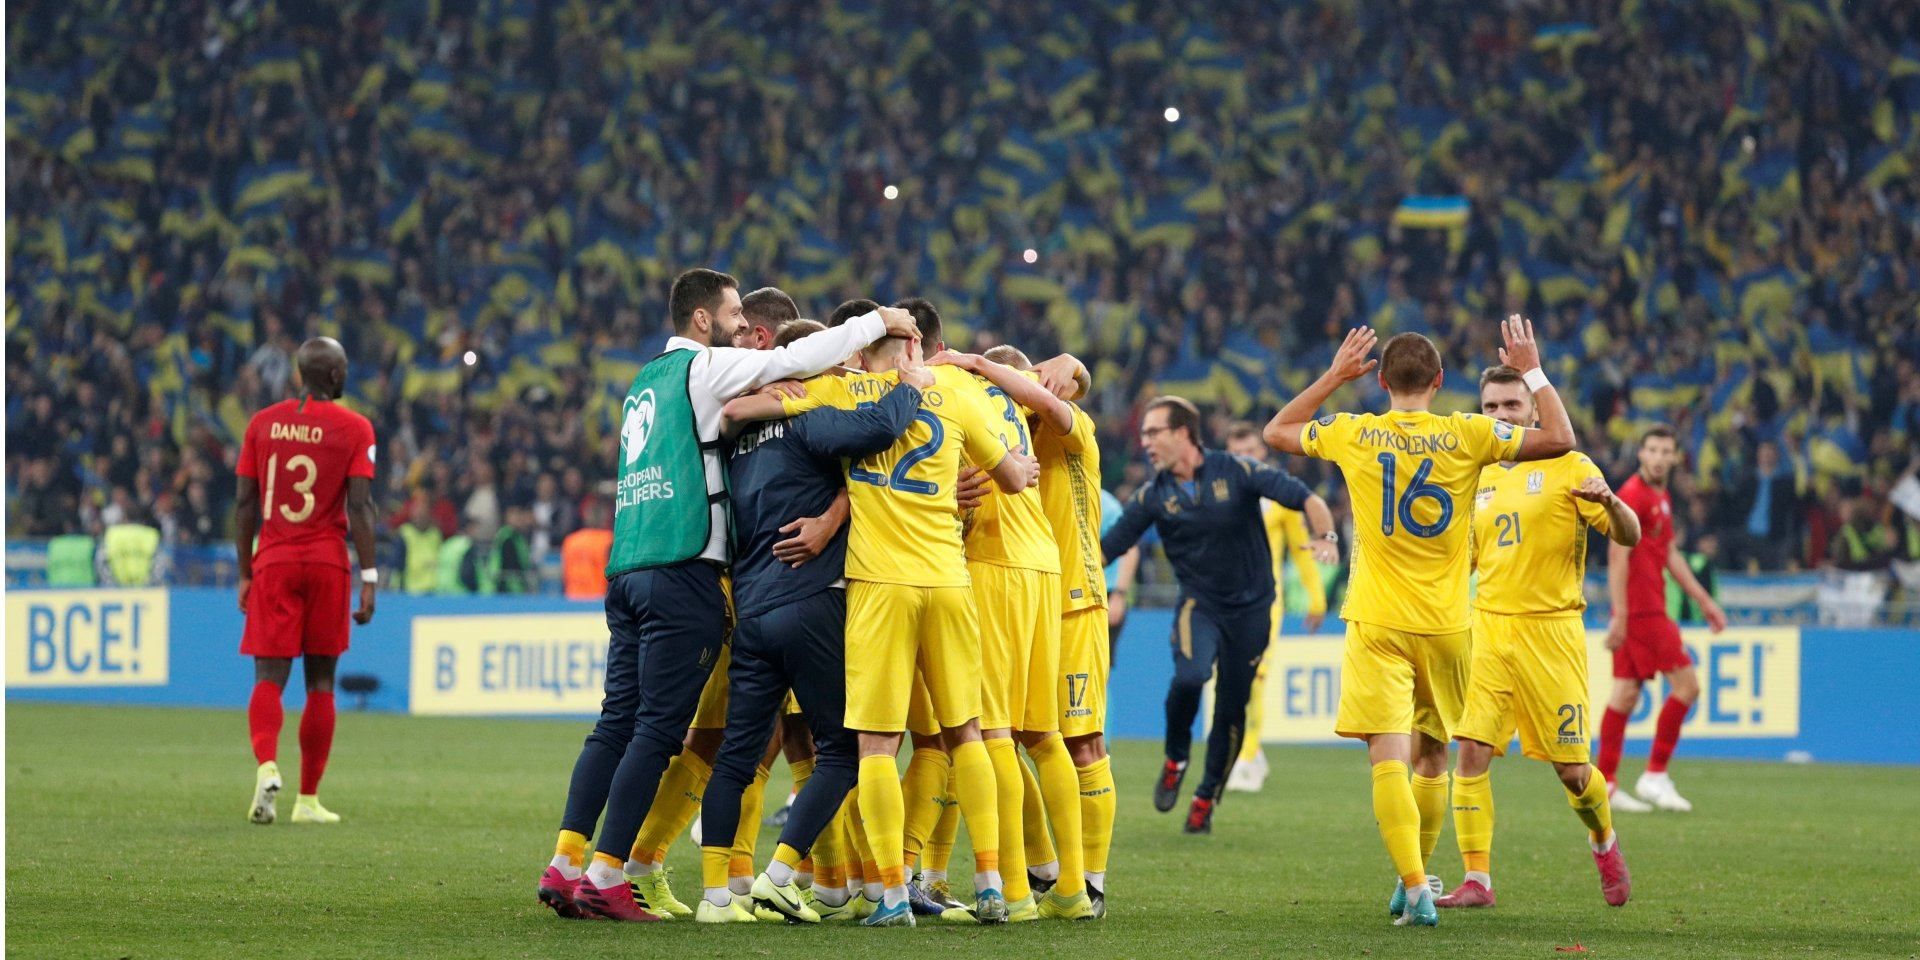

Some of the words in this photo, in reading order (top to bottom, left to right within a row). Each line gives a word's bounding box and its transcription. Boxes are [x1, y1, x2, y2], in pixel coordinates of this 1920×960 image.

[270, 422, 323, 444] DANILO
[1359, 427, 1458, 455] MYKOLENKO
[263, 452, 318, 524] 13
[617, 466, 662, 495] EROPEAN
[1377, 452, 1454, 538] 16
[1495, 512, 1521, 547] 21
[28, 603, 141, 673] ВСЕ!
[434, 645, 456, 691] В
[1066, 673, 1089, 708] 17
[1286, 667, 1341, 716] ЕП
[1557, 703, 1583, 737] 21
